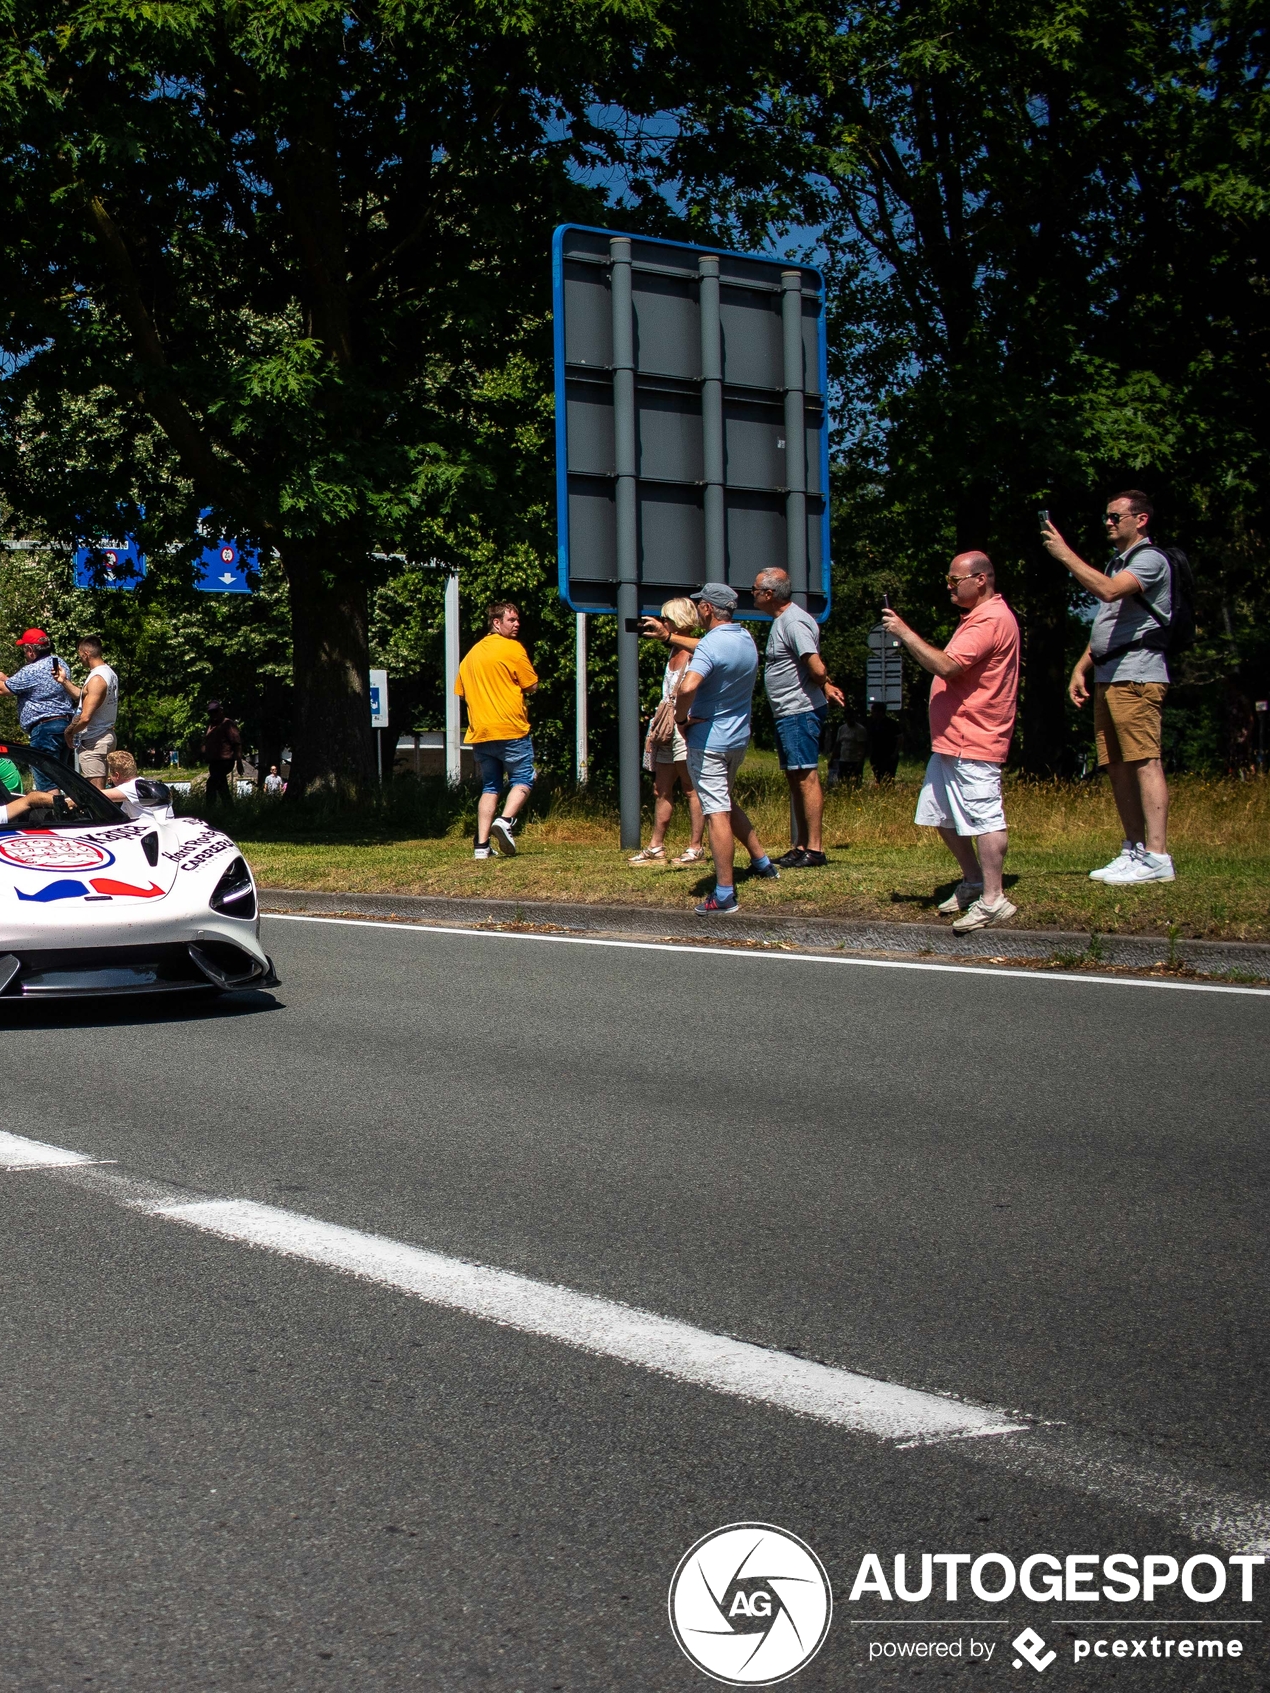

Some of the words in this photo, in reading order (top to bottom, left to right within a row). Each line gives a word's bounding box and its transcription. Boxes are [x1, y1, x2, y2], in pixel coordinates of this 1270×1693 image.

[76, 826, 151, 845] Kappa
[161, 845, 198, 863] Hard
[184, 830, 226, 847] Rock
